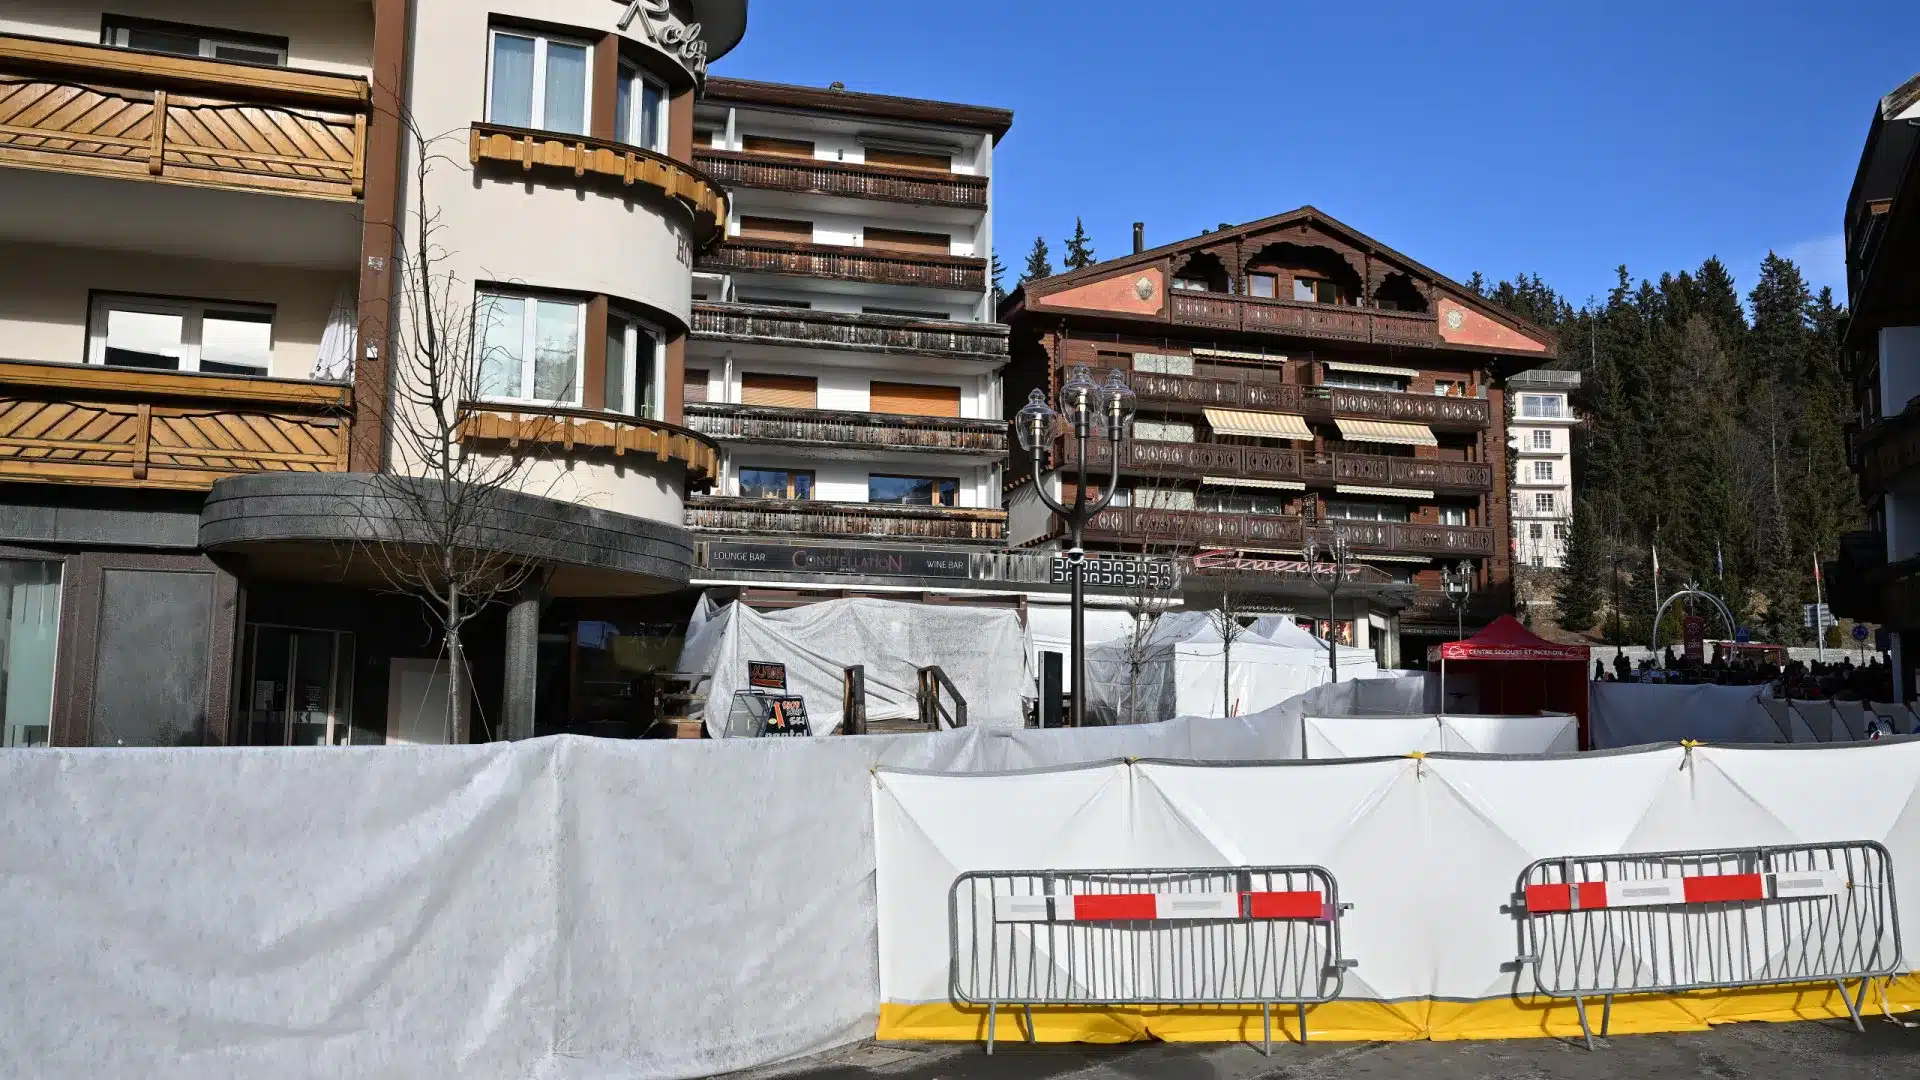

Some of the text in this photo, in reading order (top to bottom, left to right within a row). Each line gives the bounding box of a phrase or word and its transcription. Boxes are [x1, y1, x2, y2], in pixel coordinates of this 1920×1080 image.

[713, 551, 766, 561] LOUNGE BAR
[926, 560, 964, 570] WINE BAR
